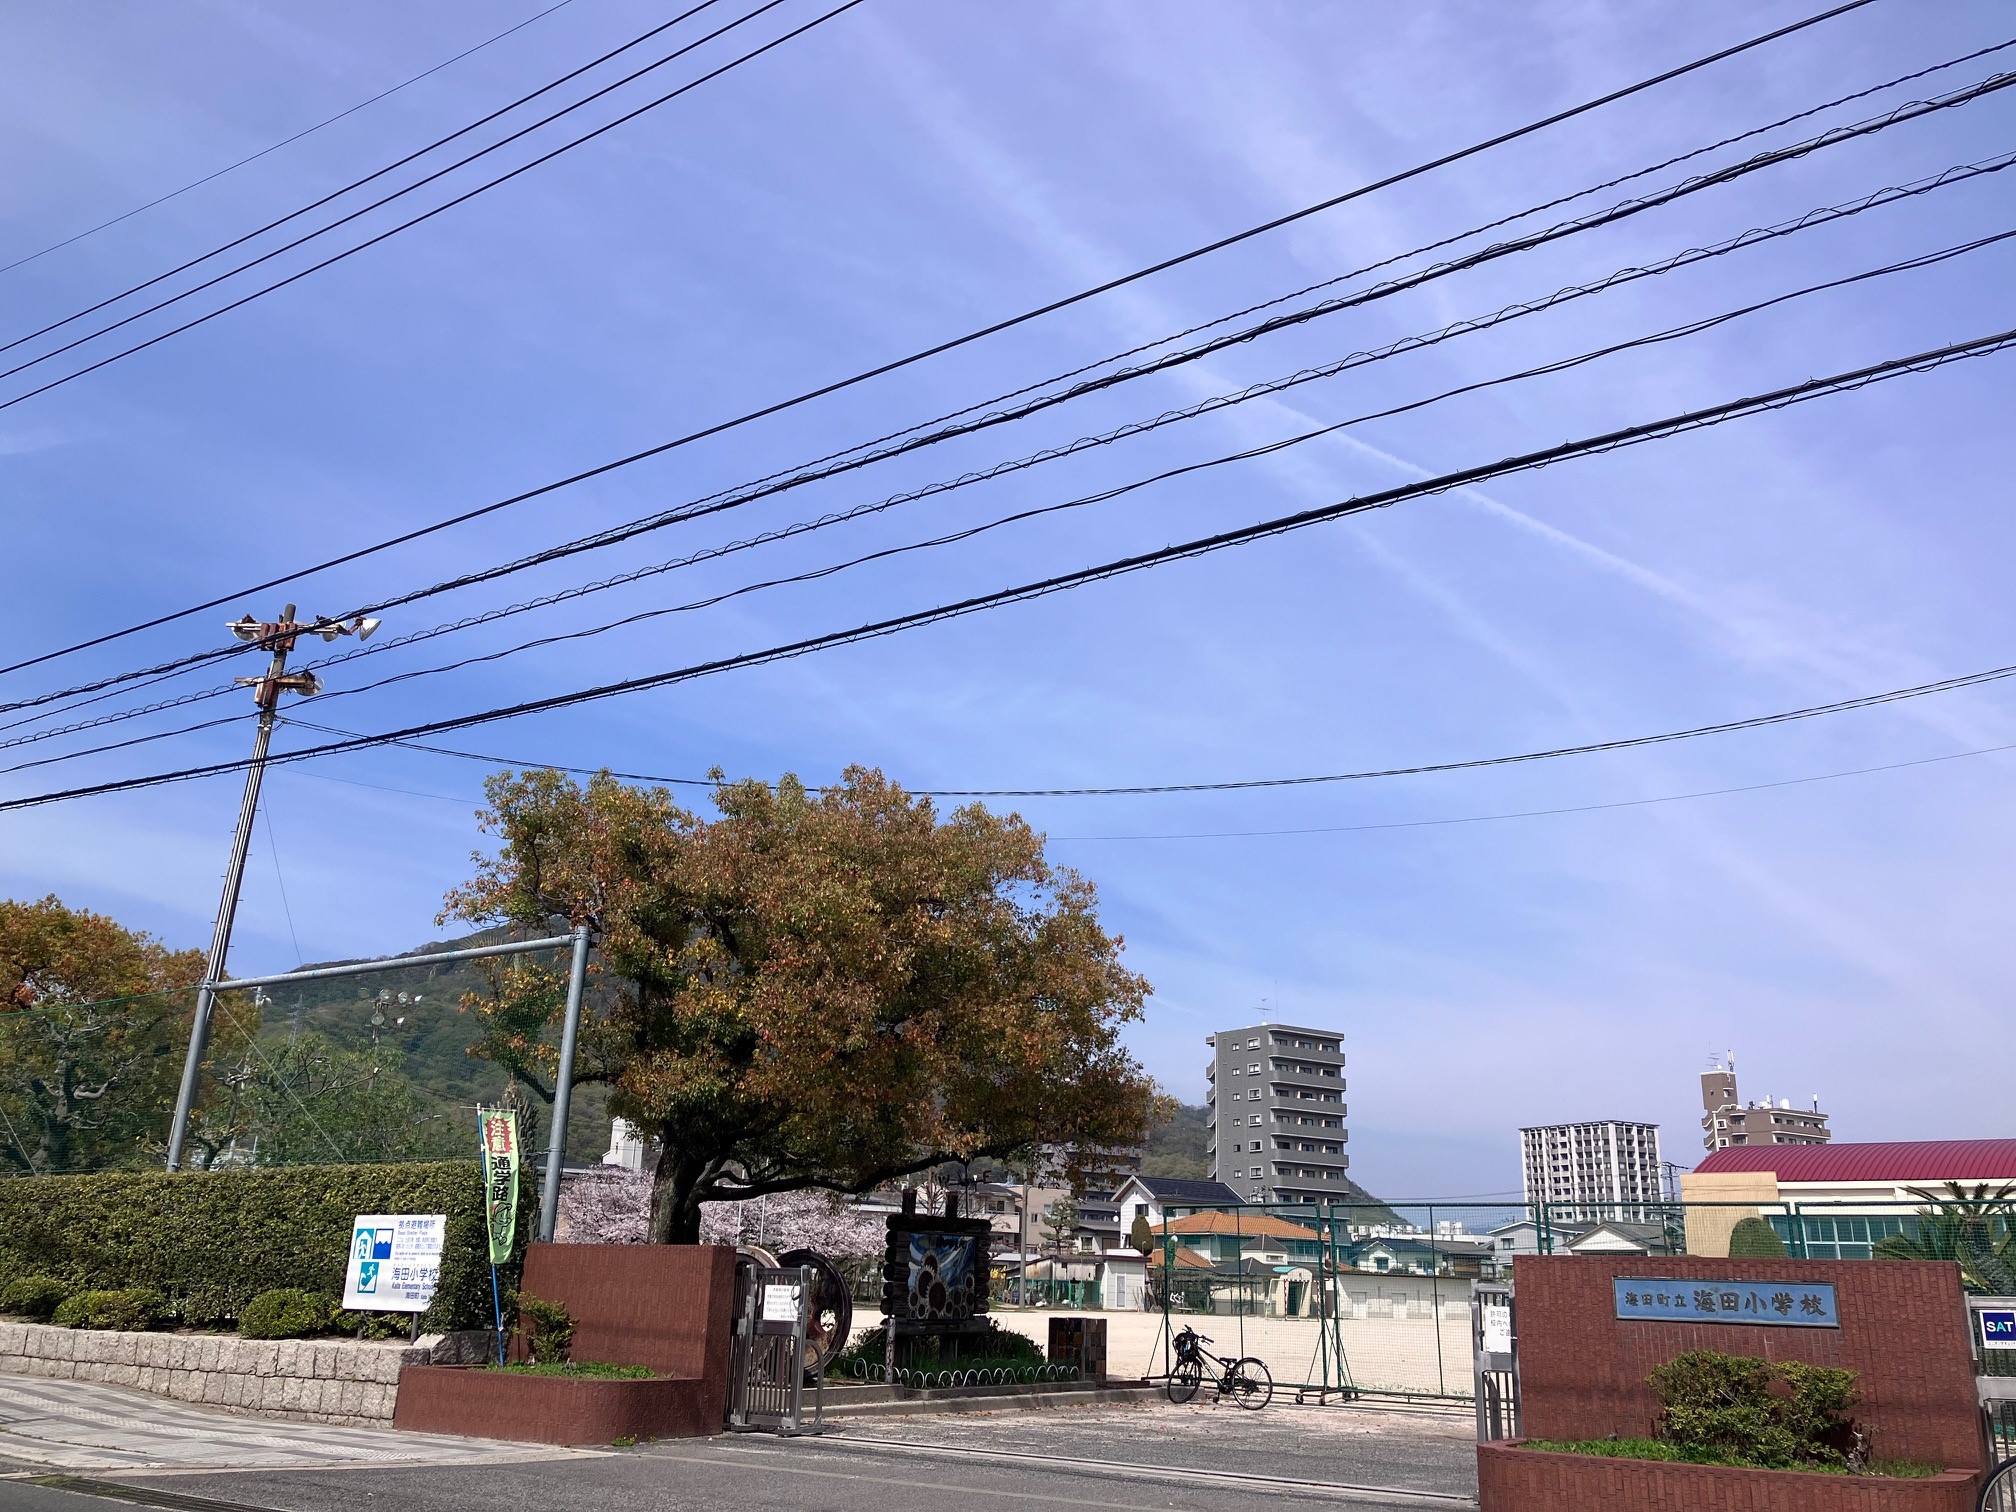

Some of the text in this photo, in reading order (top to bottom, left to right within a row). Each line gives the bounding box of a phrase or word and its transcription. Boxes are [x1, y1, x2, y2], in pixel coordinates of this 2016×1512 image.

[490, 1120, 511, 1201] 注意 通学路
[391, 1267, 439, 1282] 海田小学校
[1625, 1290, 1827, 1316] 海田町立 海田小学校
[1986, 1321, 2014, 1332] SAT
